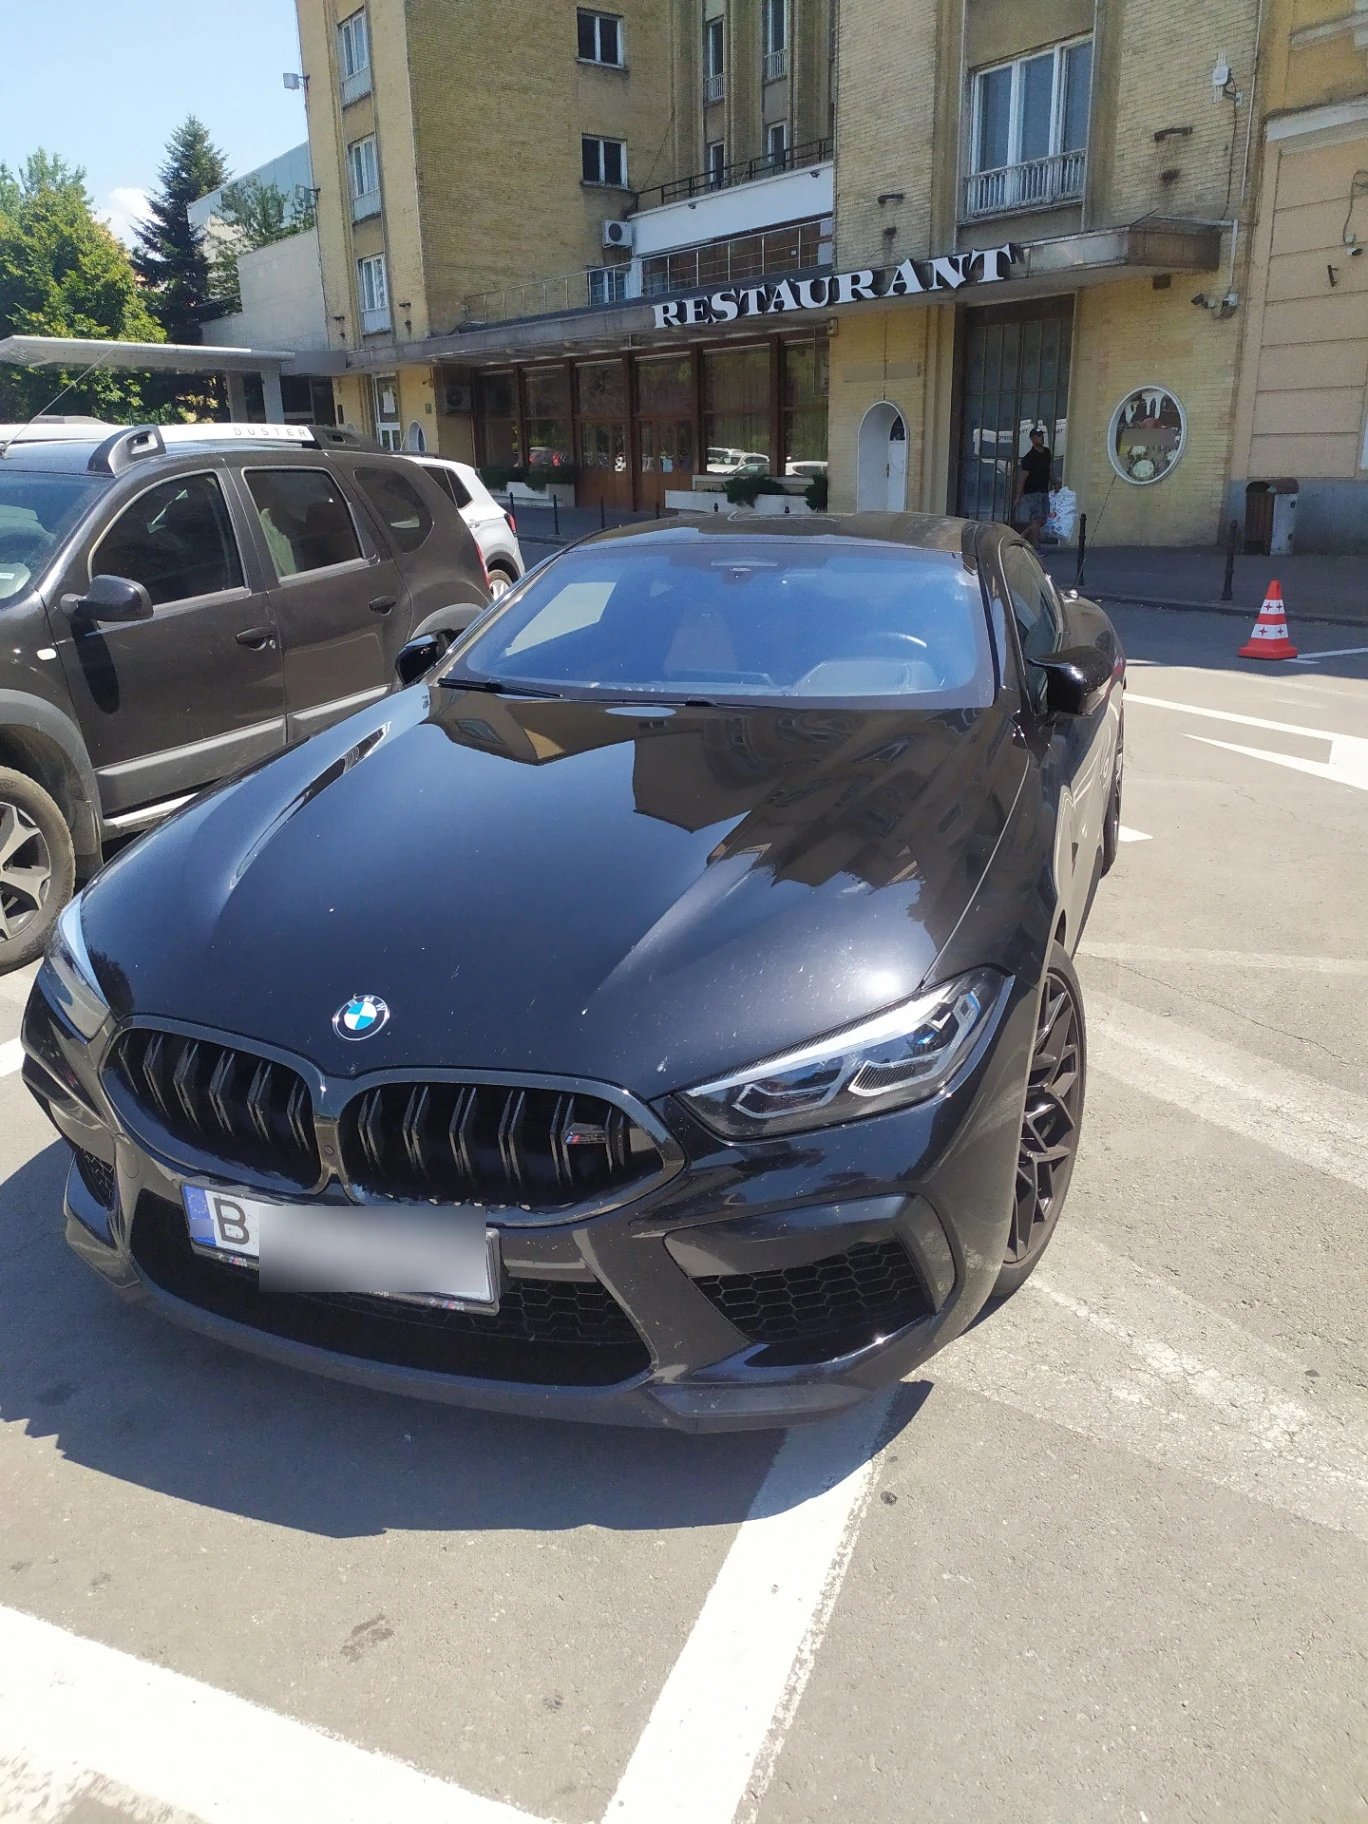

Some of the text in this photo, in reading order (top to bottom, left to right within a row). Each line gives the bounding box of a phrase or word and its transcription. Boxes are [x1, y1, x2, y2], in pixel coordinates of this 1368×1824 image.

[651, 243, 1015, 329] RESTAURANT
[233, 427, 308, 437] DUSTER
[347, 996, 387, 1012] BMW
[213, 1197, 250, 1246] B
